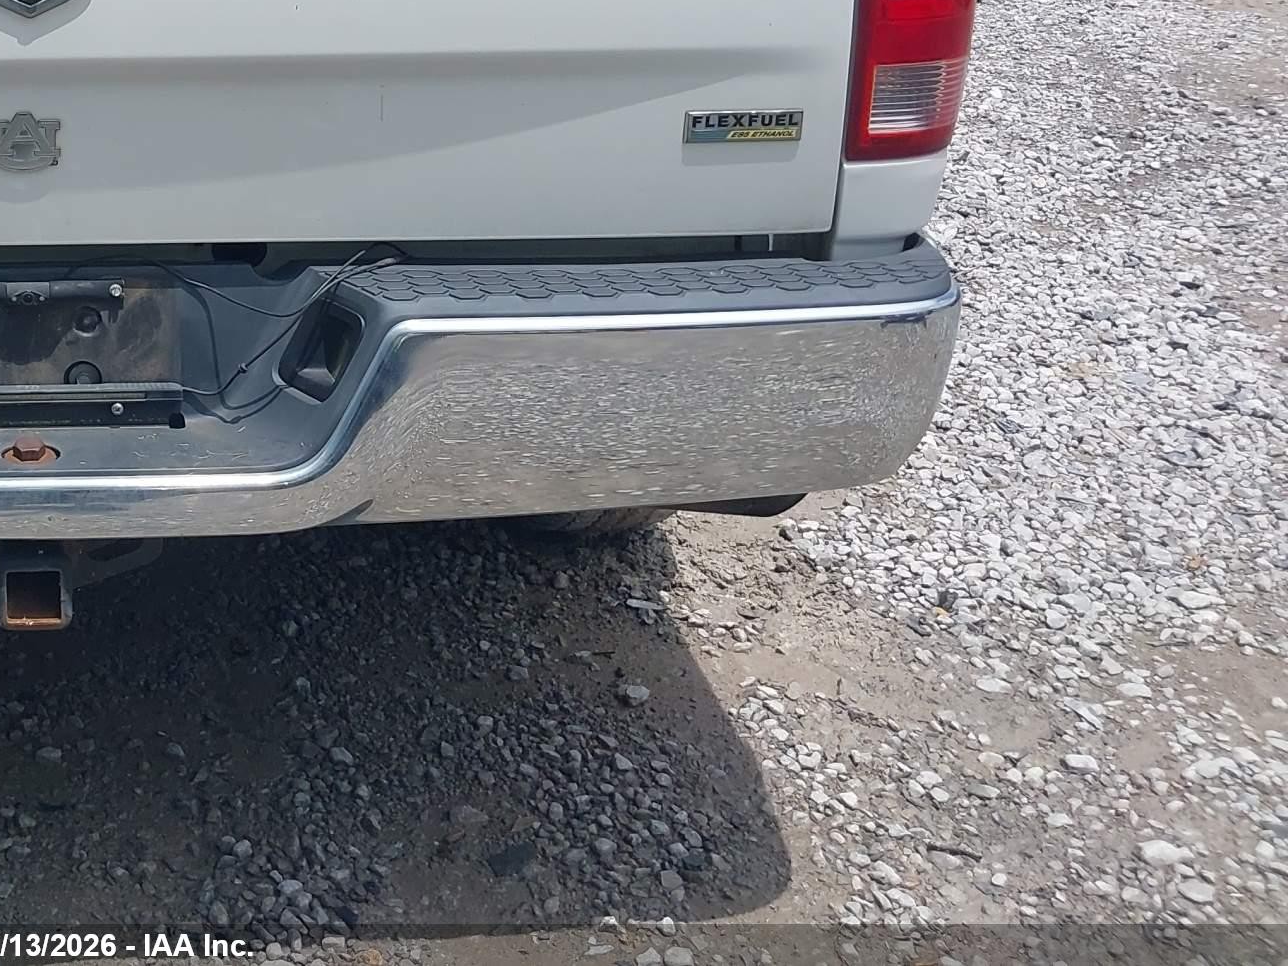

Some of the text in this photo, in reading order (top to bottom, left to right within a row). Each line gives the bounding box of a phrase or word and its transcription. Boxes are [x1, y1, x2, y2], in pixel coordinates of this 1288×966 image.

[692, 113, 799, 128] FLEXFUEL
[731, 130, 795, 138] E85 ETHANOL
